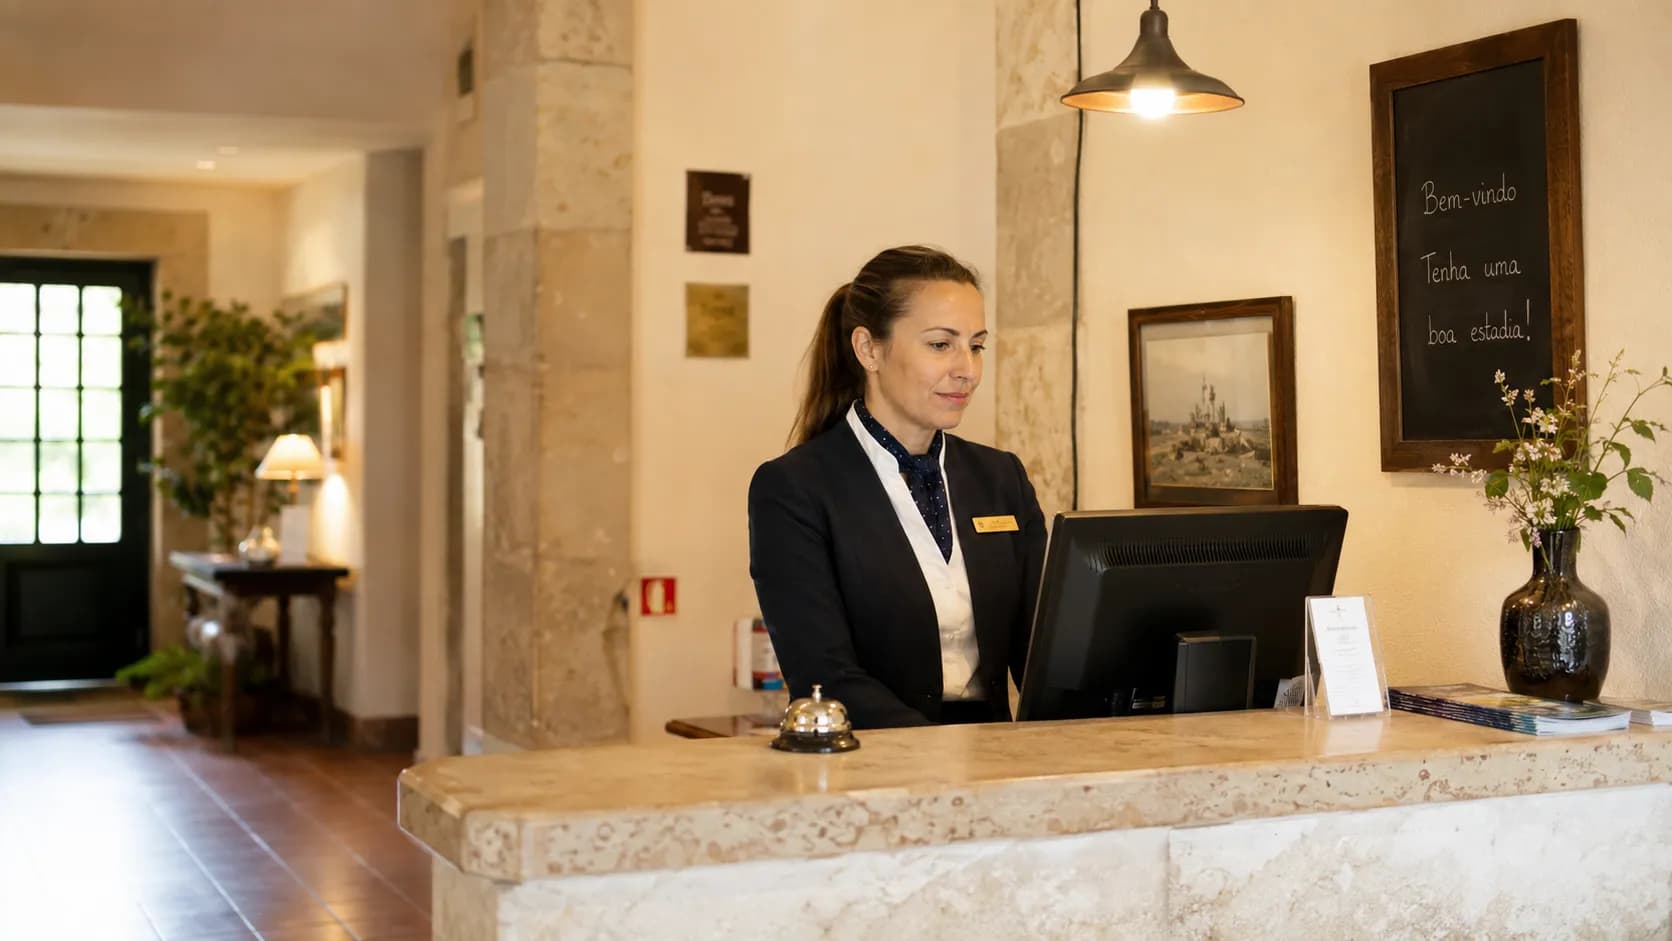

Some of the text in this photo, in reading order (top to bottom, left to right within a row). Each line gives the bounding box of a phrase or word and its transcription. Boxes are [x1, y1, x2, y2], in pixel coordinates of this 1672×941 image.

[1420, 172, 1517, 215] Bem-vindo
[1420, 249, 1521, 284] Tenha uma
[1428, 298, 1531, 345] boa estadia!
